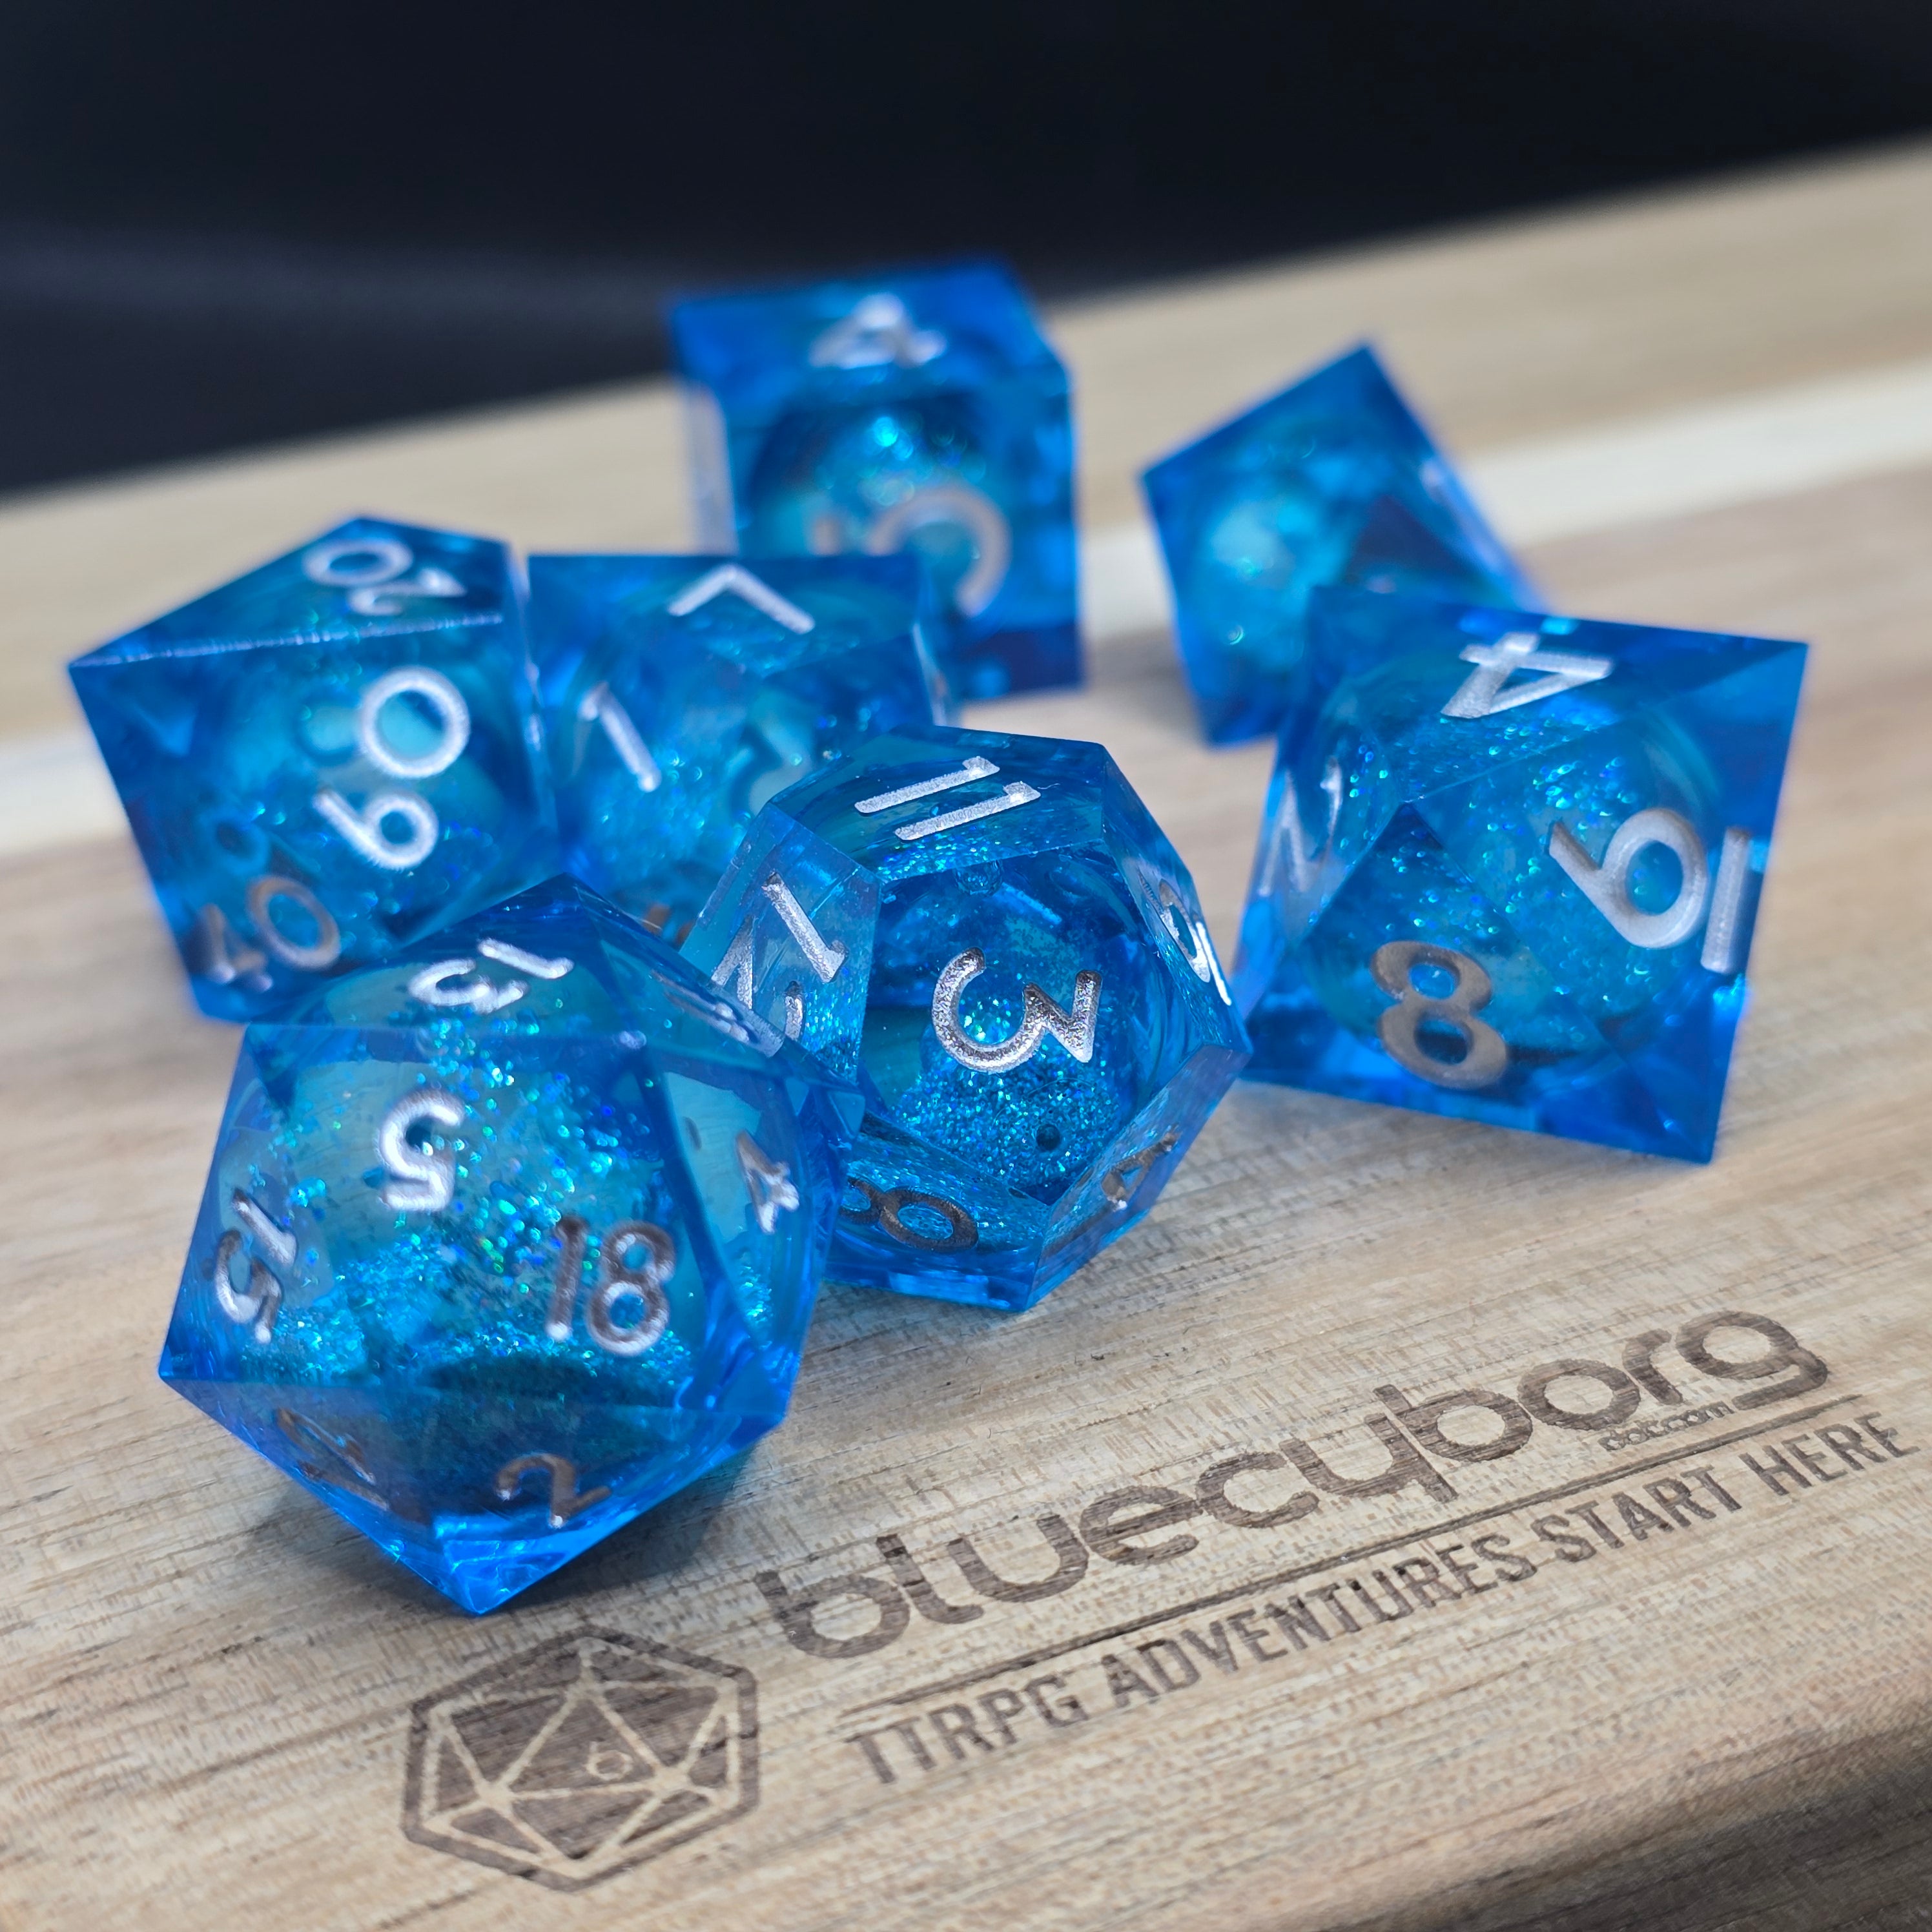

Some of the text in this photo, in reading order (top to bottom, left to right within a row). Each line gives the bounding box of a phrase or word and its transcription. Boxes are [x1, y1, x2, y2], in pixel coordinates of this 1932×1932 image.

[1440, 632, 1614, 719] 4
[854, 755, 1041, 841] 11
[409, 938, 573, 1014] 13
[932, 947, 1102, 1073] 3
[1370, 939, 1511, 1088] 8
[377, 1087, 464, 1211] 5
[736, 1130, 799, 1232] 4
[212, 1189, 298, 1343] 15
[839, 1177, 979, 1253] 8
[546, 1216, 675, 1356] 18
[496, 1450, 612, 1529] 2
[754, 1310, 1829, 1660] bluecyborg
[846, 1412, 1921, 1784] TTRPG ADVENTURES START HERE
